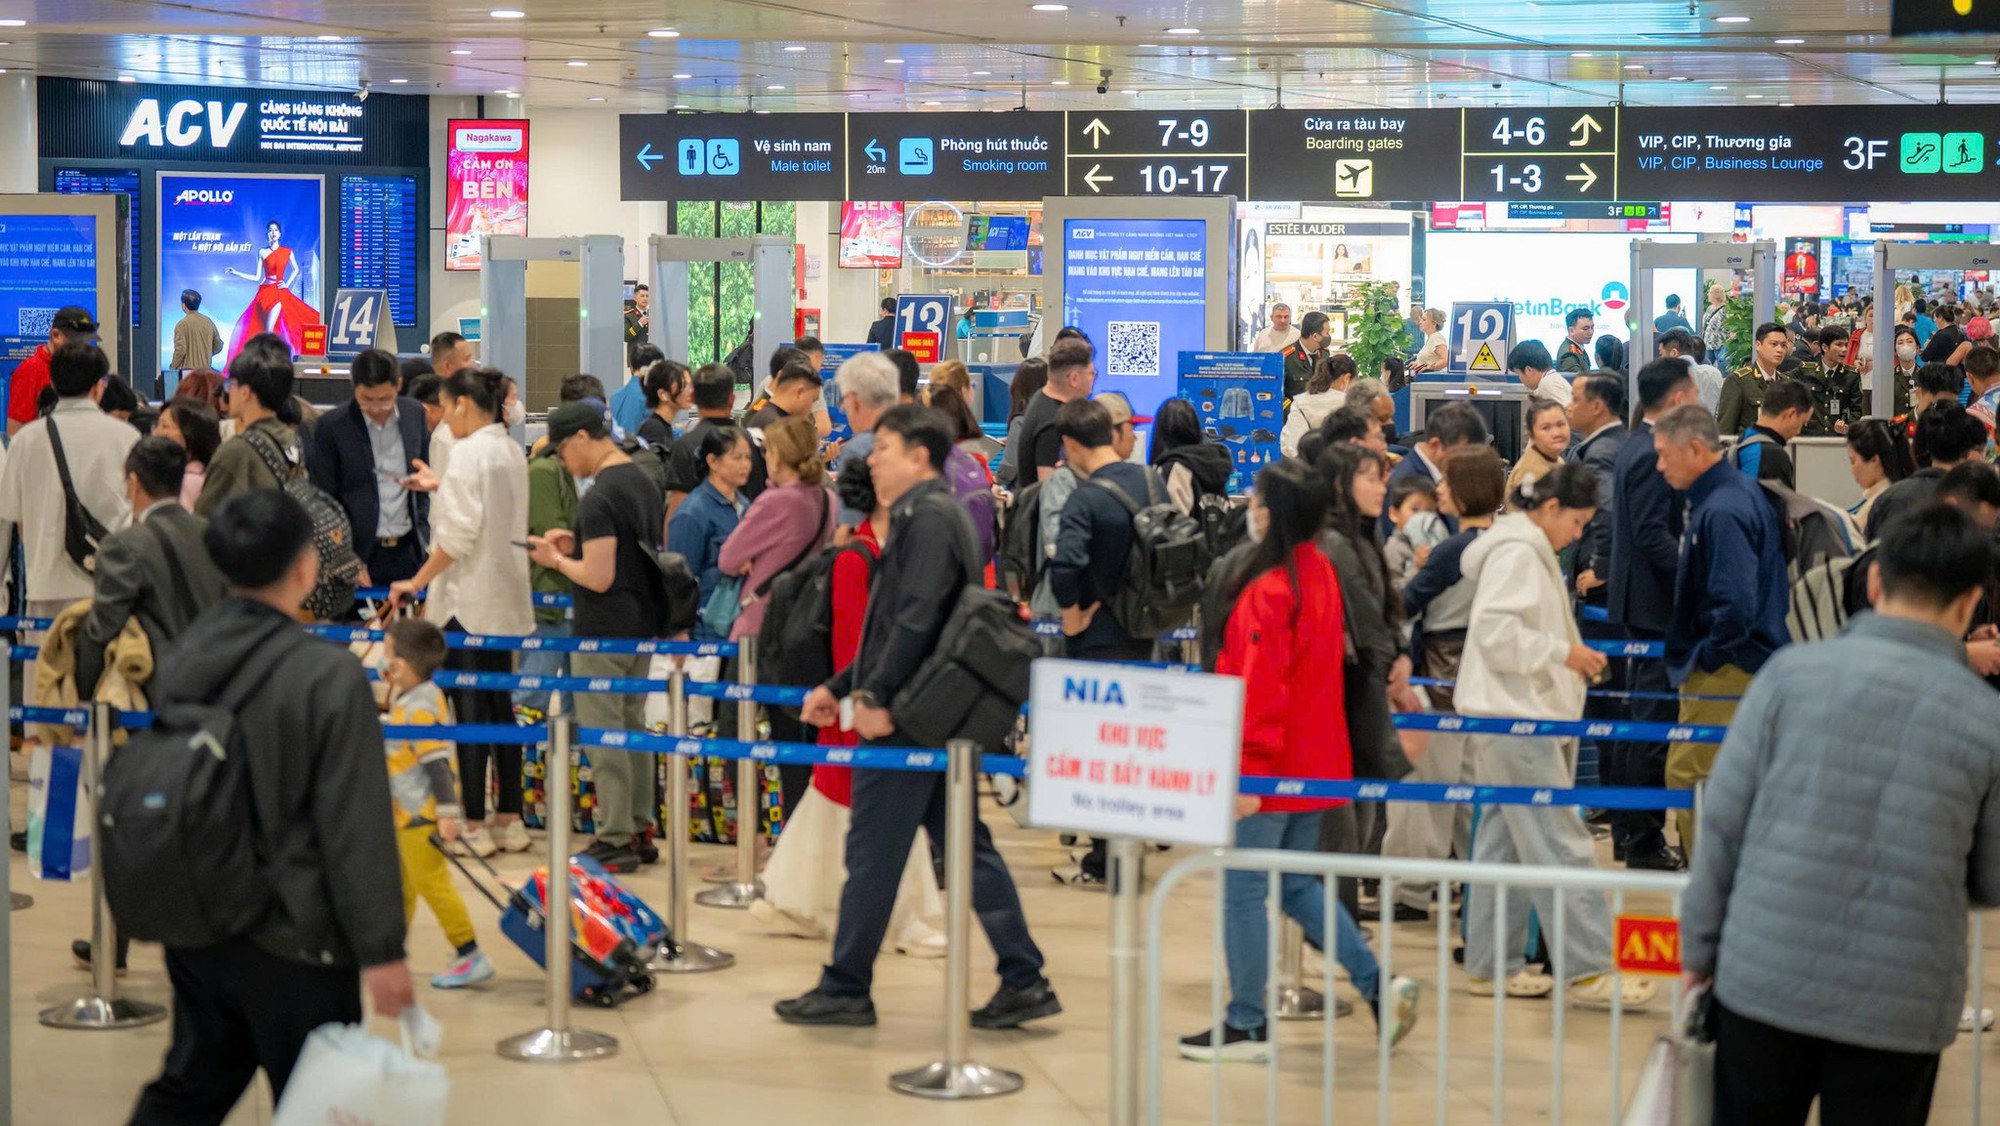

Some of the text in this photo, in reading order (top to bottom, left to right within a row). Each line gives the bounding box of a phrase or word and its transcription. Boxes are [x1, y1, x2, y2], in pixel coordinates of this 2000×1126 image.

[260, 99, 363, 117] CẢNG HÀNG KHÔNG
[119, 98, 248, 147] ACV
[261, 116, 348, 134] QUỐC TẾ NỘI BÀI
[1304, 117, 1405, 134] Cửa ra tàu bay
[466, 133, 512, 143] Nagakawa
[1158, 119, 1209, 147] 7-9
[1492, 117, 1546, 146] 4-6
[754, 140, 831, 154] Vệ sinh nam
[941, 136, 1048, 154] Phòng hút thuốc
[1307, 137, 1403, 152] Boarding gates
[1638, 135, 1791, 151] VIP, CIP, Thương gia
[1843, 136, 1889, 170] 3F
[463, 156, 514, 170] CẢM ƠN
[771, 160, 831, 172] Male toilet
[866, 165, 886, 174] 20m
[963, 159, 1047, 174] Smoking room
[1638, 156, 1823, 173] VIP, CIP, Business Lounge
[1140, 165, 1229, 193] 10-17
[1490, 164, 1542, 193] 1-3
[463, 176, 513, 199] BÊN
[174, 190, 233, 204] APOLLO
[1608, 206, 1622, 216] 3F
[1269, 223, 1345, 235] ESTÉE LAUDER
[332, 296, 374, 345] 14
[898, 301, 944, 349] 13
[1455, 308, 1504, 362] 12
[1036, 623, 1060, 634] ACV
[1172, 628, 1197, 639] ACV
[464, 637, 484, 647] ACV
[522, 639, 542, 649] ACV
[579, 640, 599, 651] ACV
[637, 642, 657, 652] ACV
[698, 643, 718, 654] ACV
[1623, 644, 1649, 654] ACV
[456, 674, 478, 685] ACV
[519, 677, 541, 688] ACV
[589, 679, 611, 690] ACV
[725, 685, 753, 698] ACV
[1064, 675, 1125, 707] NIA
[1437, 718, 1463, 729] ACV
[1511, 722, 1536, 734] ACV
[1586, 724, 1612, 735] ACV
[601, 732, 627, 745] ACV
[1667, 727, 1693, 739] ACV
[676, 741, 702, 754] ACV
[751, 745, 777, 758] ACV
[827, 749, 853, 762] ACV
[906, 752, 934, 766] ACV
[1275, 780, 1304, 794] ACV
[1358, 784, 1388, 798] ACV
[1444, 787, 1475, 800] ACV
